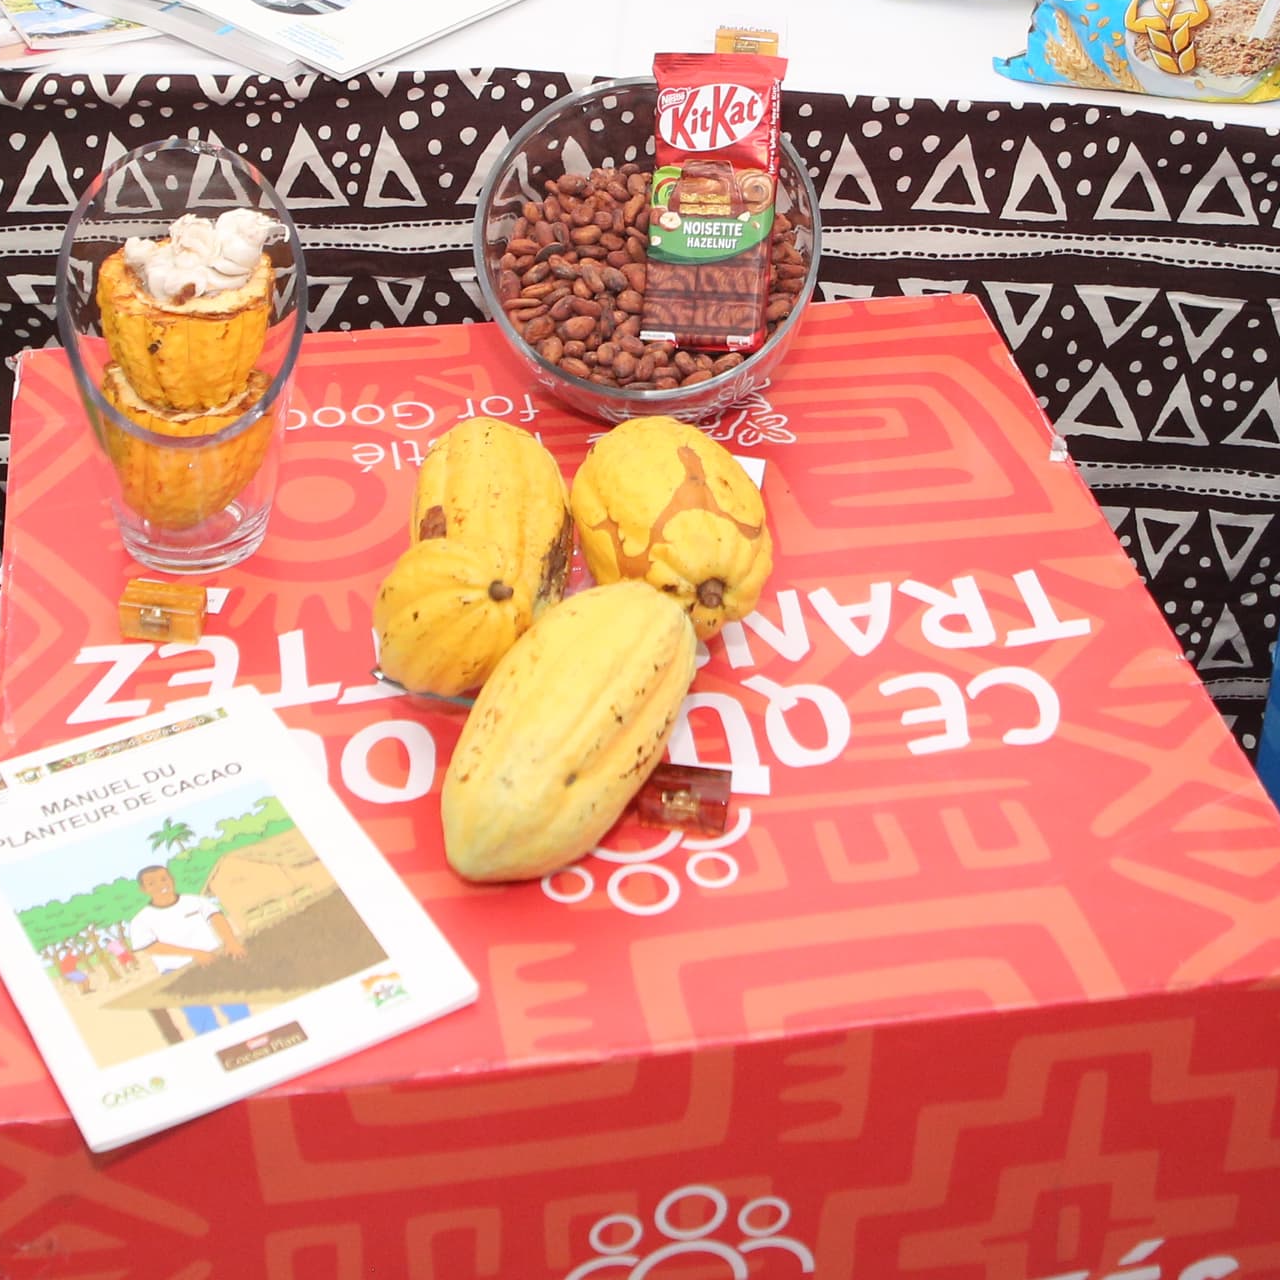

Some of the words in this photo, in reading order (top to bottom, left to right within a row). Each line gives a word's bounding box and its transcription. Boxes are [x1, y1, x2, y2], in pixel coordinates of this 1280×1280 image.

[670, 85, 759, 150] KitKat
[682, 220, 744, 237] NOISETTE
[686, 236, 739, 250] HAZELNUT
[457, 393, 540, 422] for
[665, 674, 852, 772] QU
[878, 665, 1062, 756] CE
[40, 778, 141, 818] MANUEL
[142, 763, 177, 786] DU
[121, 790, 158, 814] DE
[160, 761, 244, 799] CACAO
